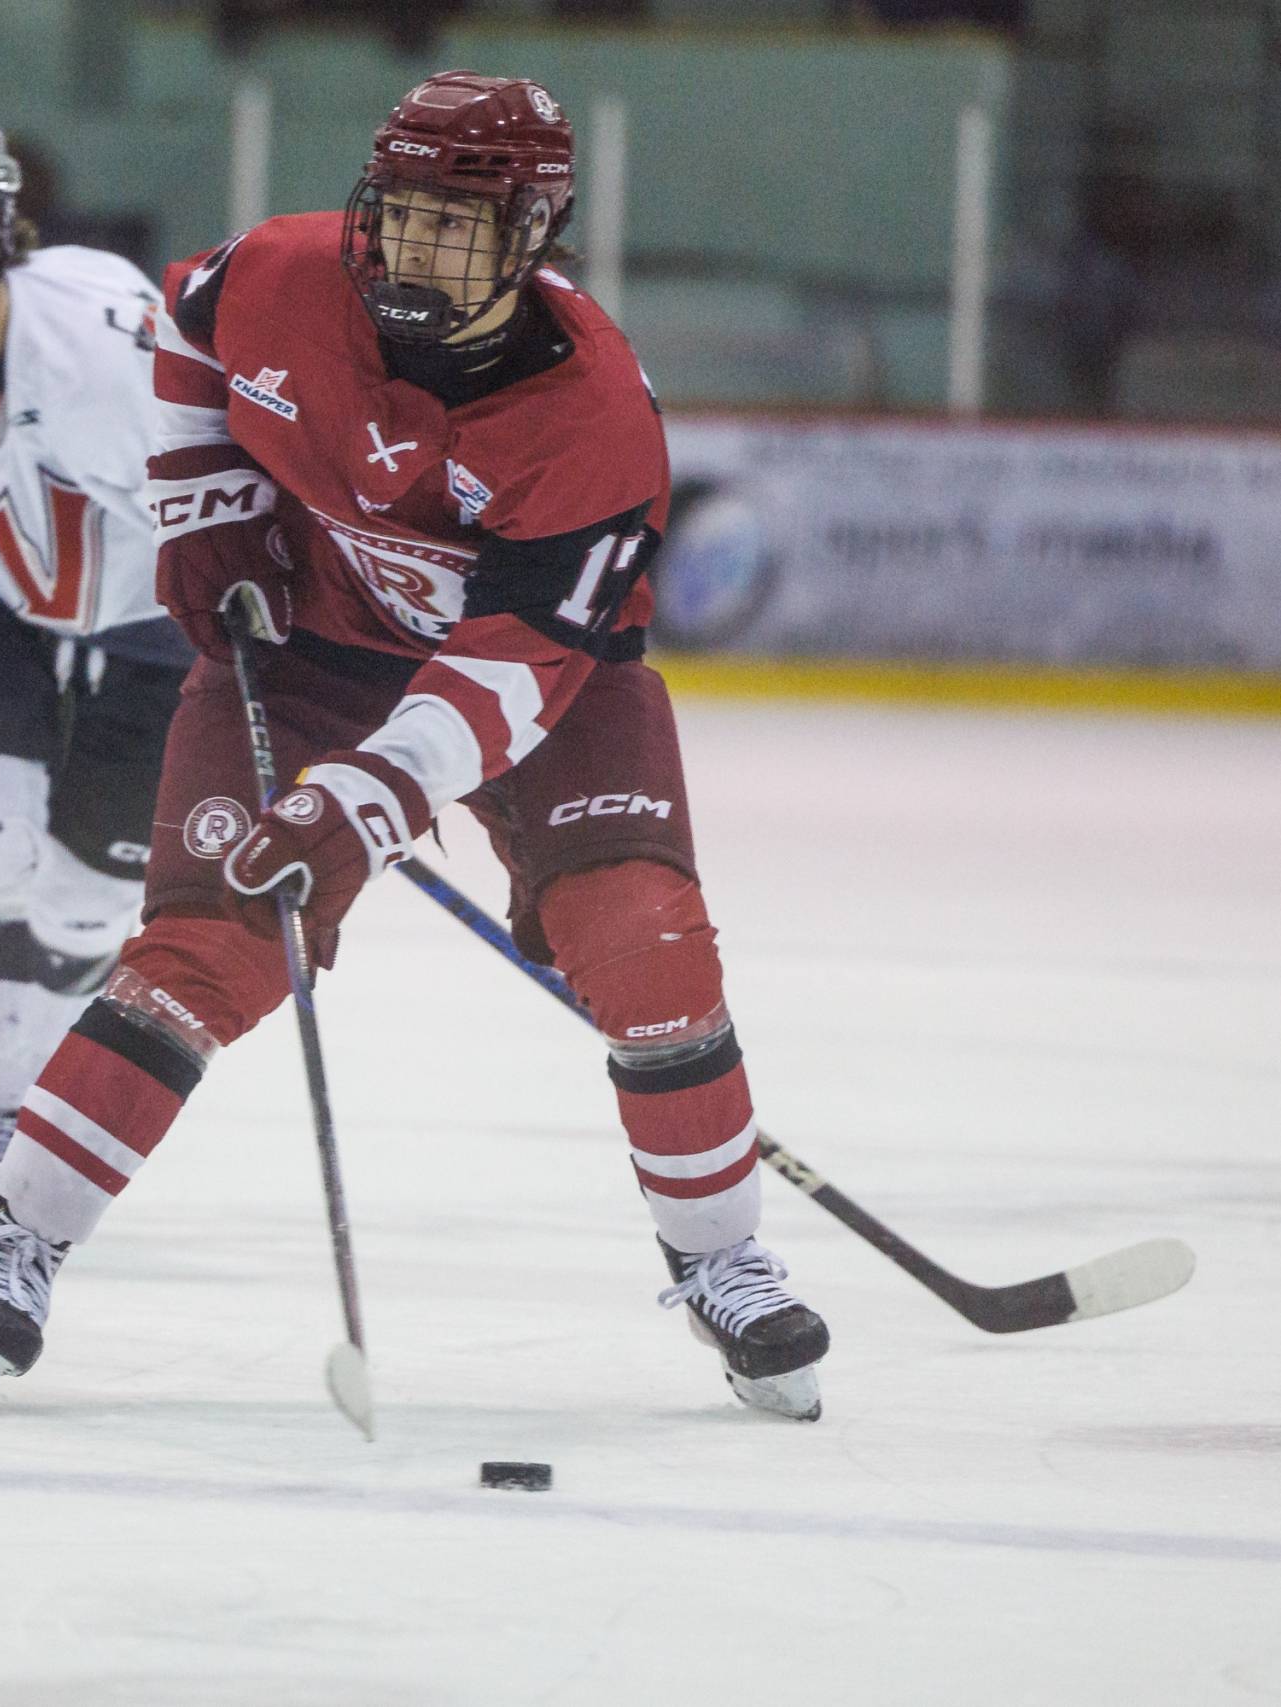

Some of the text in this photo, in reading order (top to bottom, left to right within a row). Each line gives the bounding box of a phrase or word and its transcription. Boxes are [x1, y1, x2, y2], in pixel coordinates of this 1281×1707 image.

[388, 140, 441, 157] CCM
[536, 163, 570, 174] CCM
[234, 379, 294, 415] KNAPPER
[149, 482, 259, 531] CM
[246, 700, 276, 777] CCM
[548, 793, 672, 827] CCM
[204, 814, 229, 841] R
[150, 988, 205, 1030] CCM
[626, 1015, 689, 1038] CCM
